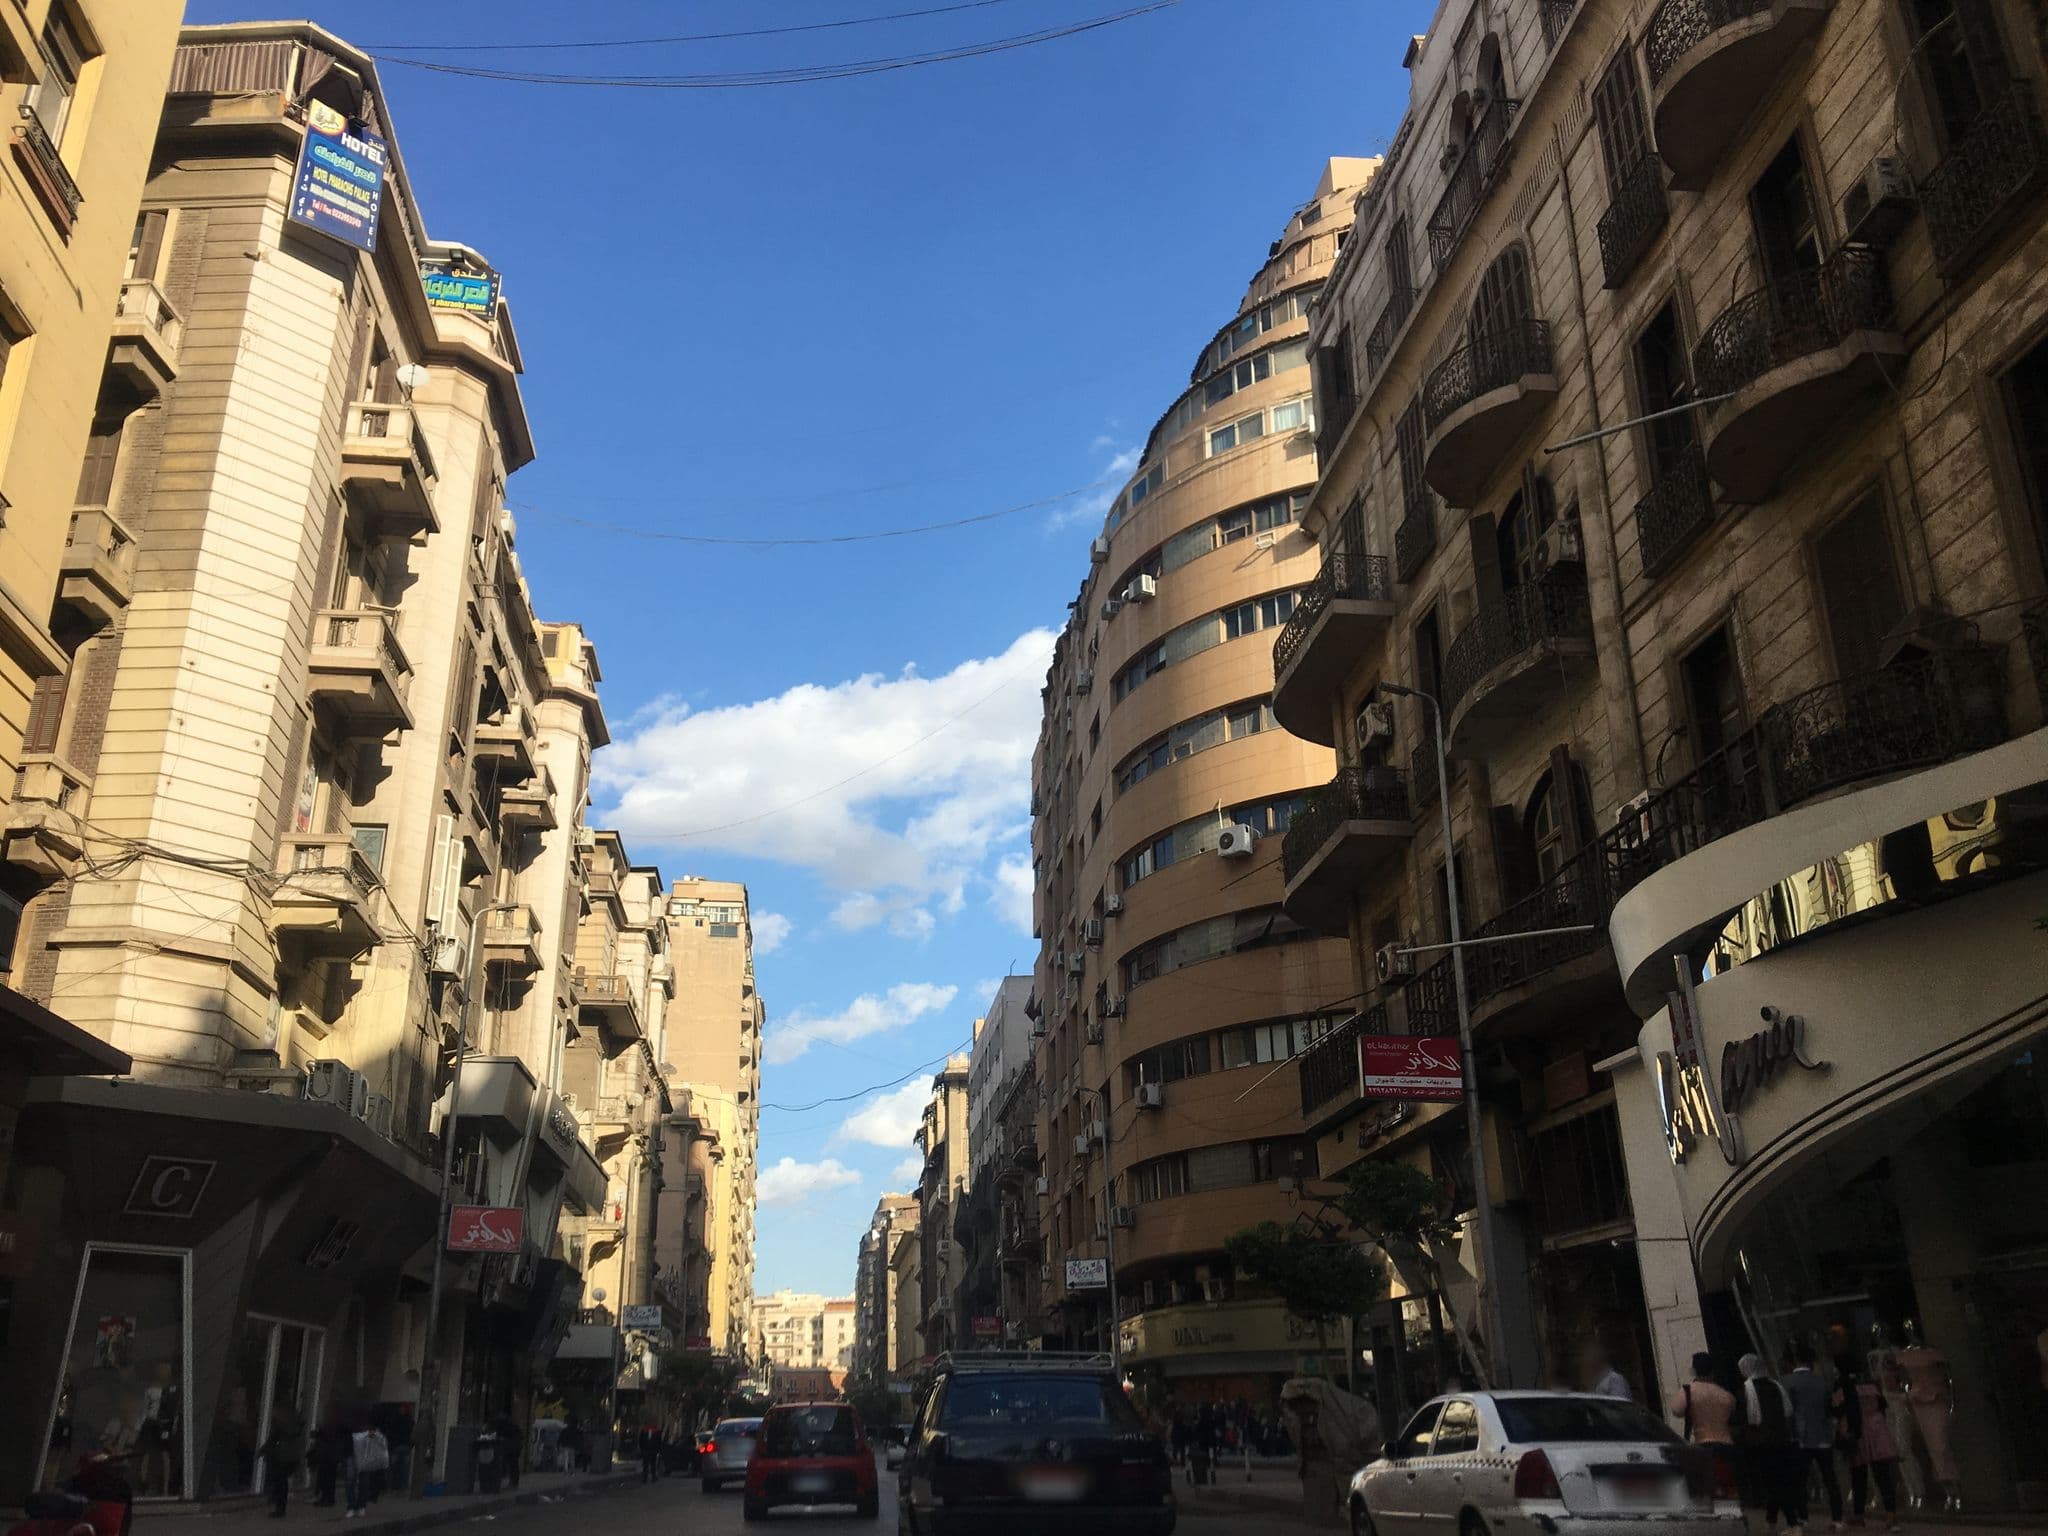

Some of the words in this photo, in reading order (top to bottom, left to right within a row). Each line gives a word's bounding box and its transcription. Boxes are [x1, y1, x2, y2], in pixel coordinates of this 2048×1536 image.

[341, 132, 384, 165] HOTEL
[313, 166, 328, 184] HOTEL
[367, 191, 379, 247] HOTEL
[452, 268, 487, 279] فندق
[463, 284, 489, 302] قصر
[1405, 1038, 1461, 1072] الكوثر
[151, 1166, 192, 1208] C
[462, 1210, 515, 1243] الكوثر
